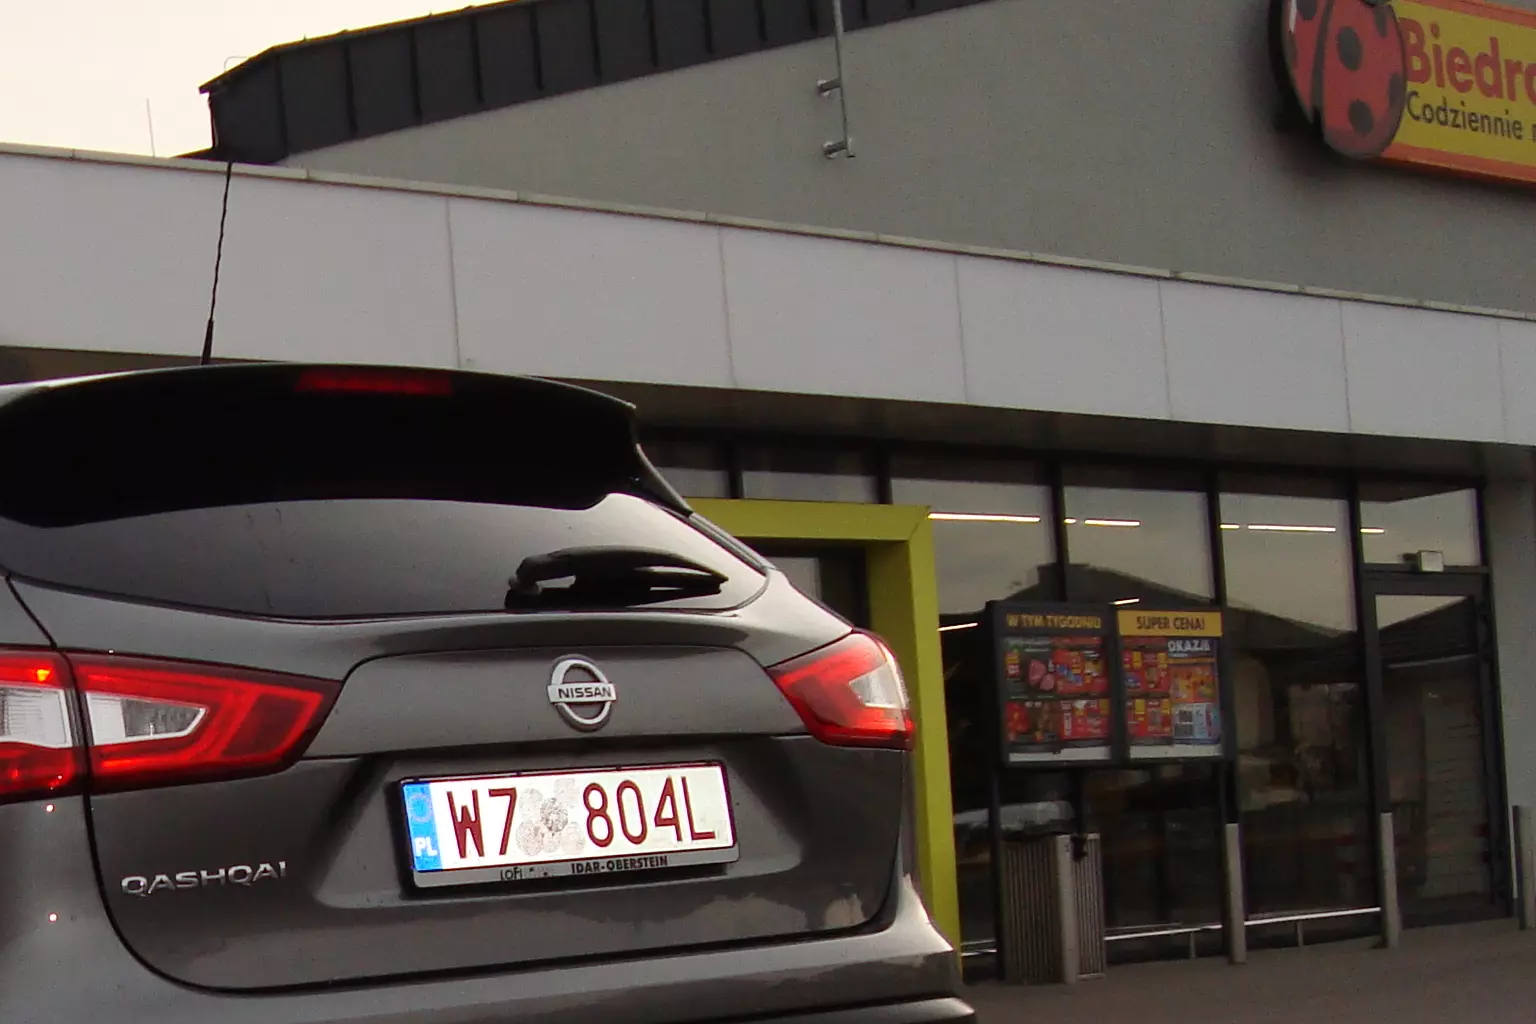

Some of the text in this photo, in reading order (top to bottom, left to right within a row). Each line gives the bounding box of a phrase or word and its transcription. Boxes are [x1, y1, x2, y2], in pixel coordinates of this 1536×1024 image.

[1407, 90, 1523, 140] Codziennie
[1021, 614, 1043, 628] TYM
[1136, 616, 1205, 630] SUPER CENA!
[558, 687, 611, 698] NISSAN
[447, 776, 716, 859] W7 804L
[415, 837, 437, 857] PL
[571, 856, 668, 874] IDAR-OBERSTEIN
[121, 861, 286, 897] QASHQAI
